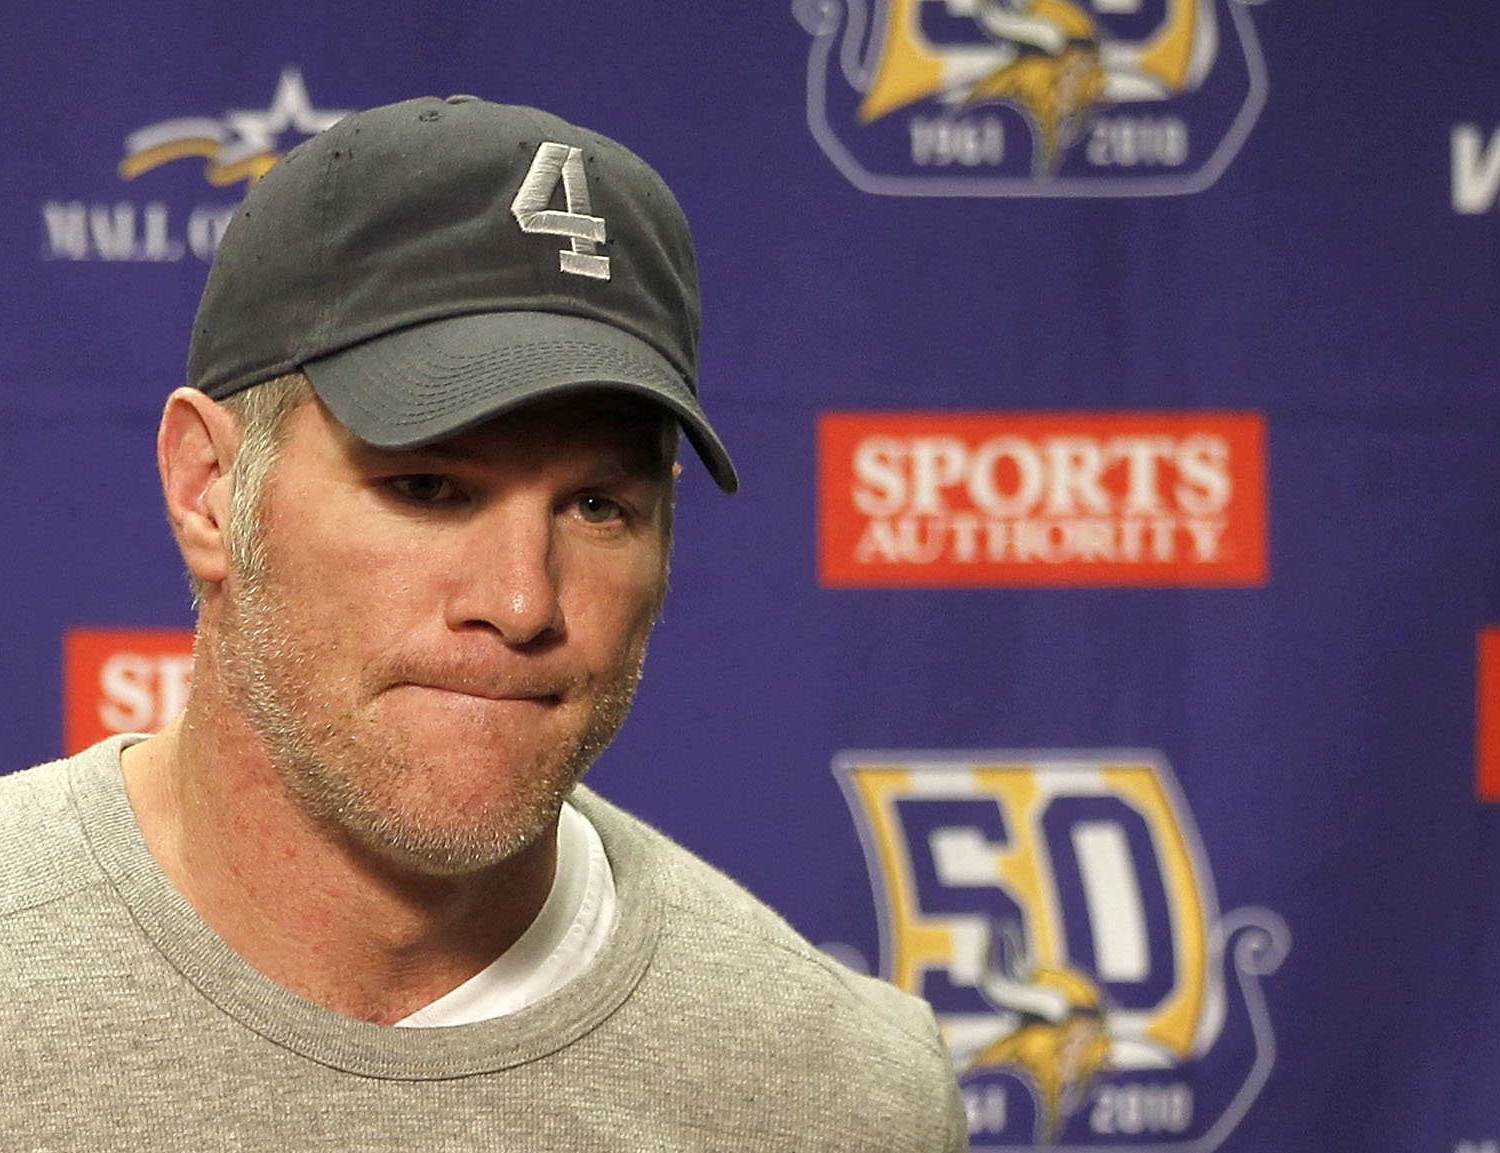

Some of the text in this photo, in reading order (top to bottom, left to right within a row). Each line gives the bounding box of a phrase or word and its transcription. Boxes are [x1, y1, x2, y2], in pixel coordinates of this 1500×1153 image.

[510, 141, 610, 280] 4
[851, 433, 1233, 518] SPORTS
[855, 514, 1229, 564] AUTHORITY
